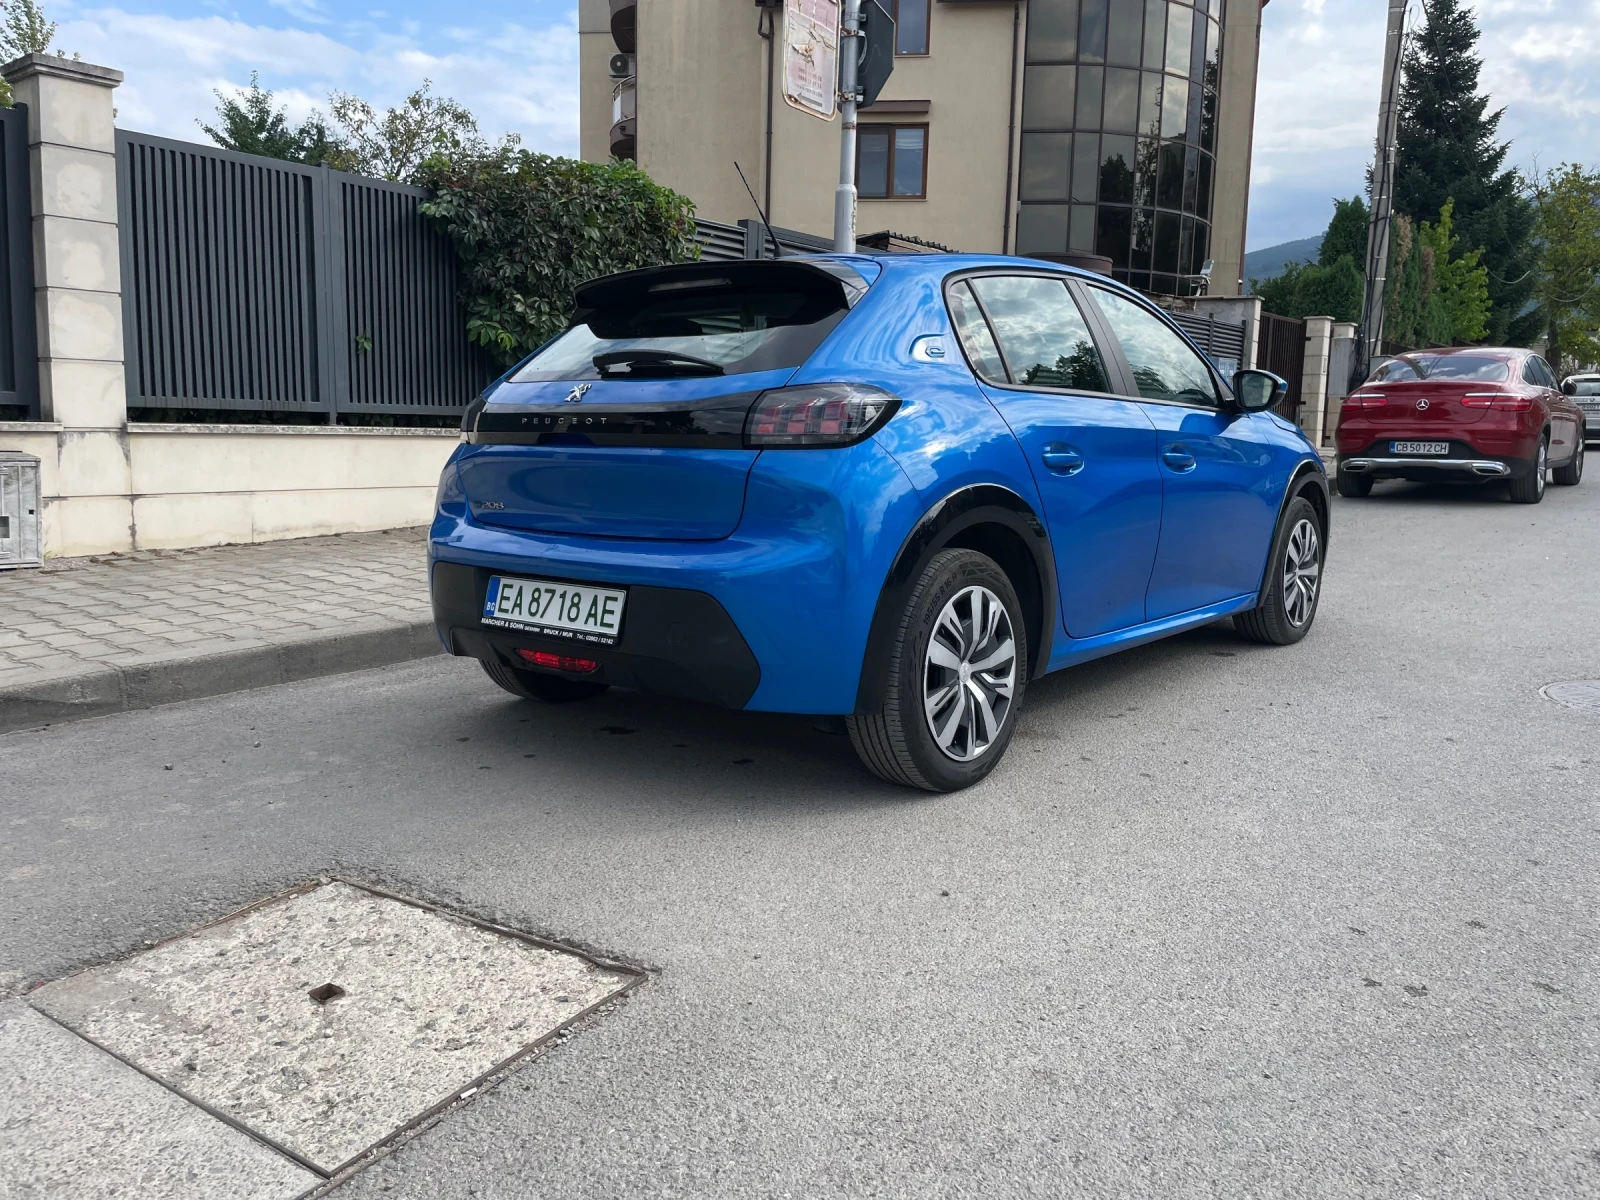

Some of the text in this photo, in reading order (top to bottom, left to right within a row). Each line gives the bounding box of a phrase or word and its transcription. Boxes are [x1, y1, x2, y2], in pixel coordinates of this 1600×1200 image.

[1396, 443, 1448, 453] CB 5012 CH
[486, 601, 496, 612] BG
[498, 583, 618, 628] EA 8718 AE
[481, 618, 505, 626] MARCHER
[509, 621, 524, 630] SOHN
[543, 628, 560, 636] BRUCK
